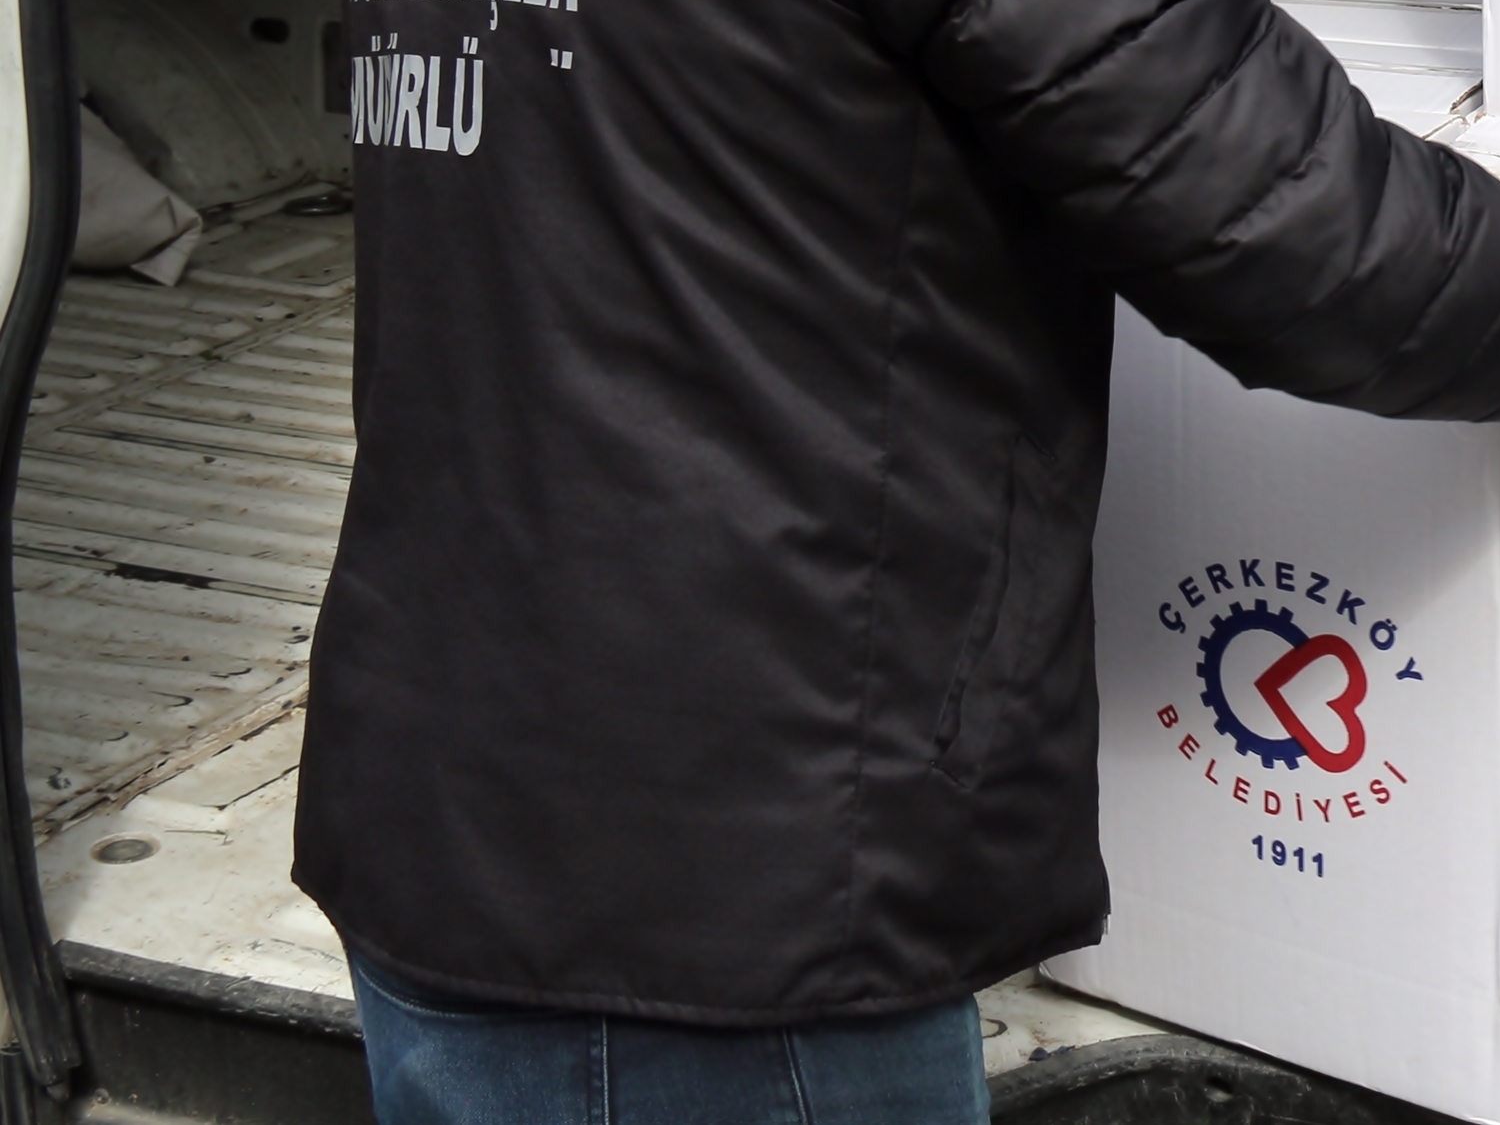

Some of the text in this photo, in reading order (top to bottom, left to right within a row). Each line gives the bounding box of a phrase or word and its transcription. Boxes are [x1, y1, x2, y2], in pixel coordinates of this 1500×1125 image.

[1157, 558, 1424, 681] ÇERKEZKÖY
[1156, 704, 1408, 823] BELEDİYESİ
[1251, 834, 1325, 878] 1911
